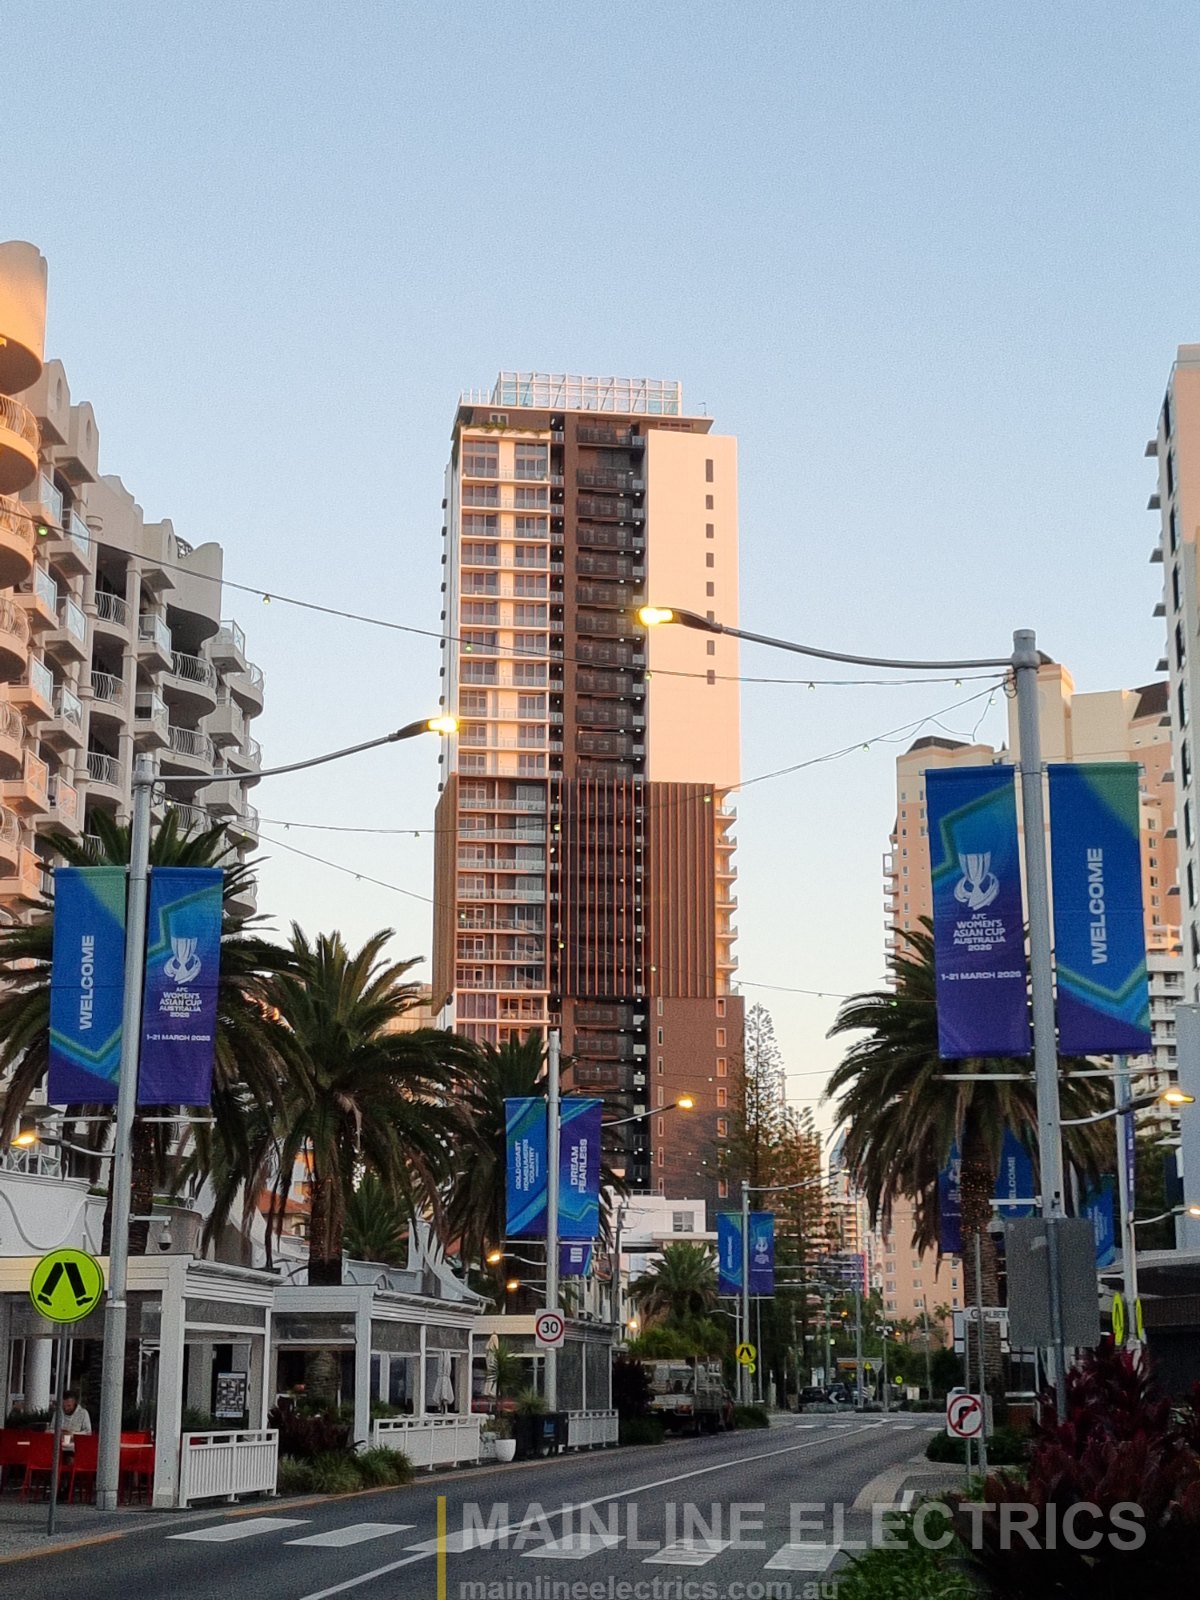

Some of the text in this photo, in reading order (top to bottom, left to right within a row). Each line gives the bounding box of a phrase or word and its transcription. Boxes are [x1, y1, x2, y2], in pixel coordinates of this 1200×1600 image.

[1087, 848, 1107, 965] WELCOME
[956, 920, 1003, 929] WOMEN'S
[953, 927, 1006, 938] ASIAN CUP
[953, 936, 1006, 945] AUSTRALIA
[960, 971, 995, 980] MARCH
[80, 935, 95, 1031] WELCOME
[163, 991, 200, 999] WOMEN'S
[159, 998, 202, 1006] ASIAN CUP
[161, 1033, 190, 1041] MARCH
[571, 1146, 579, 1186] DREAM
[579, 1138, 588, 1193] FEARLESS
[541, 1321, 559, 1334] 30
